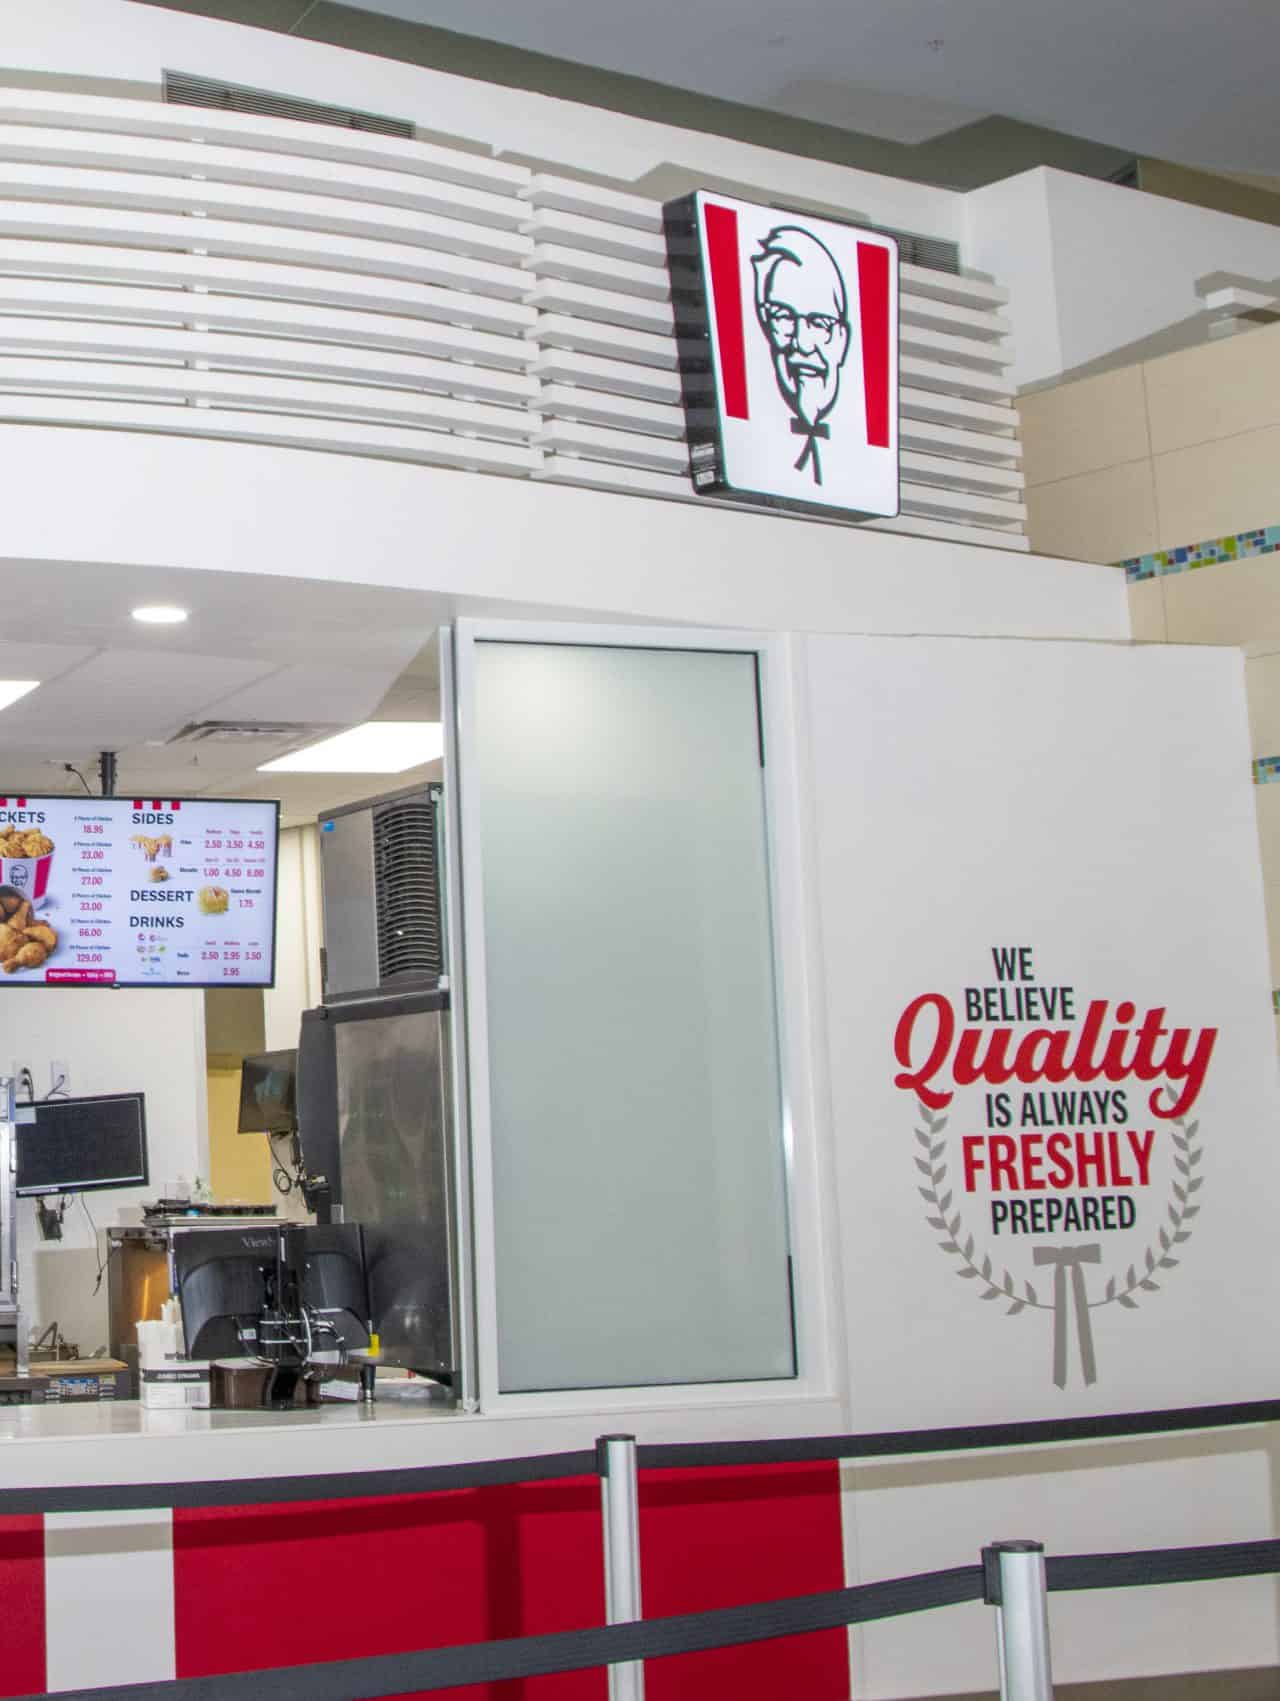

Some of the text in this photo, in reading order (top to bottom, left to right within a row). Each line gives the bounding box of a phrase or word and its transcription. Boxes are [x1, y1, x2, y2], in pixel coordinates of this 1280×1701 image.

[132, 813, 174, 825] SIDES
[130, 890, 194, 902] DESSERT
[129, 916, 185, 929] DRINKS
[992, 947, 1034, 981] WE
[965, 986, 1076, 1022] BELIEVE
[893, 992, 1218, 1120] Quality
[985, 1089, 1128, 1128] IS ALWAYS
[961, 1129, 1155, 1193] FRESHLY
[990, 1195, 1137, 1236] PREPARED
